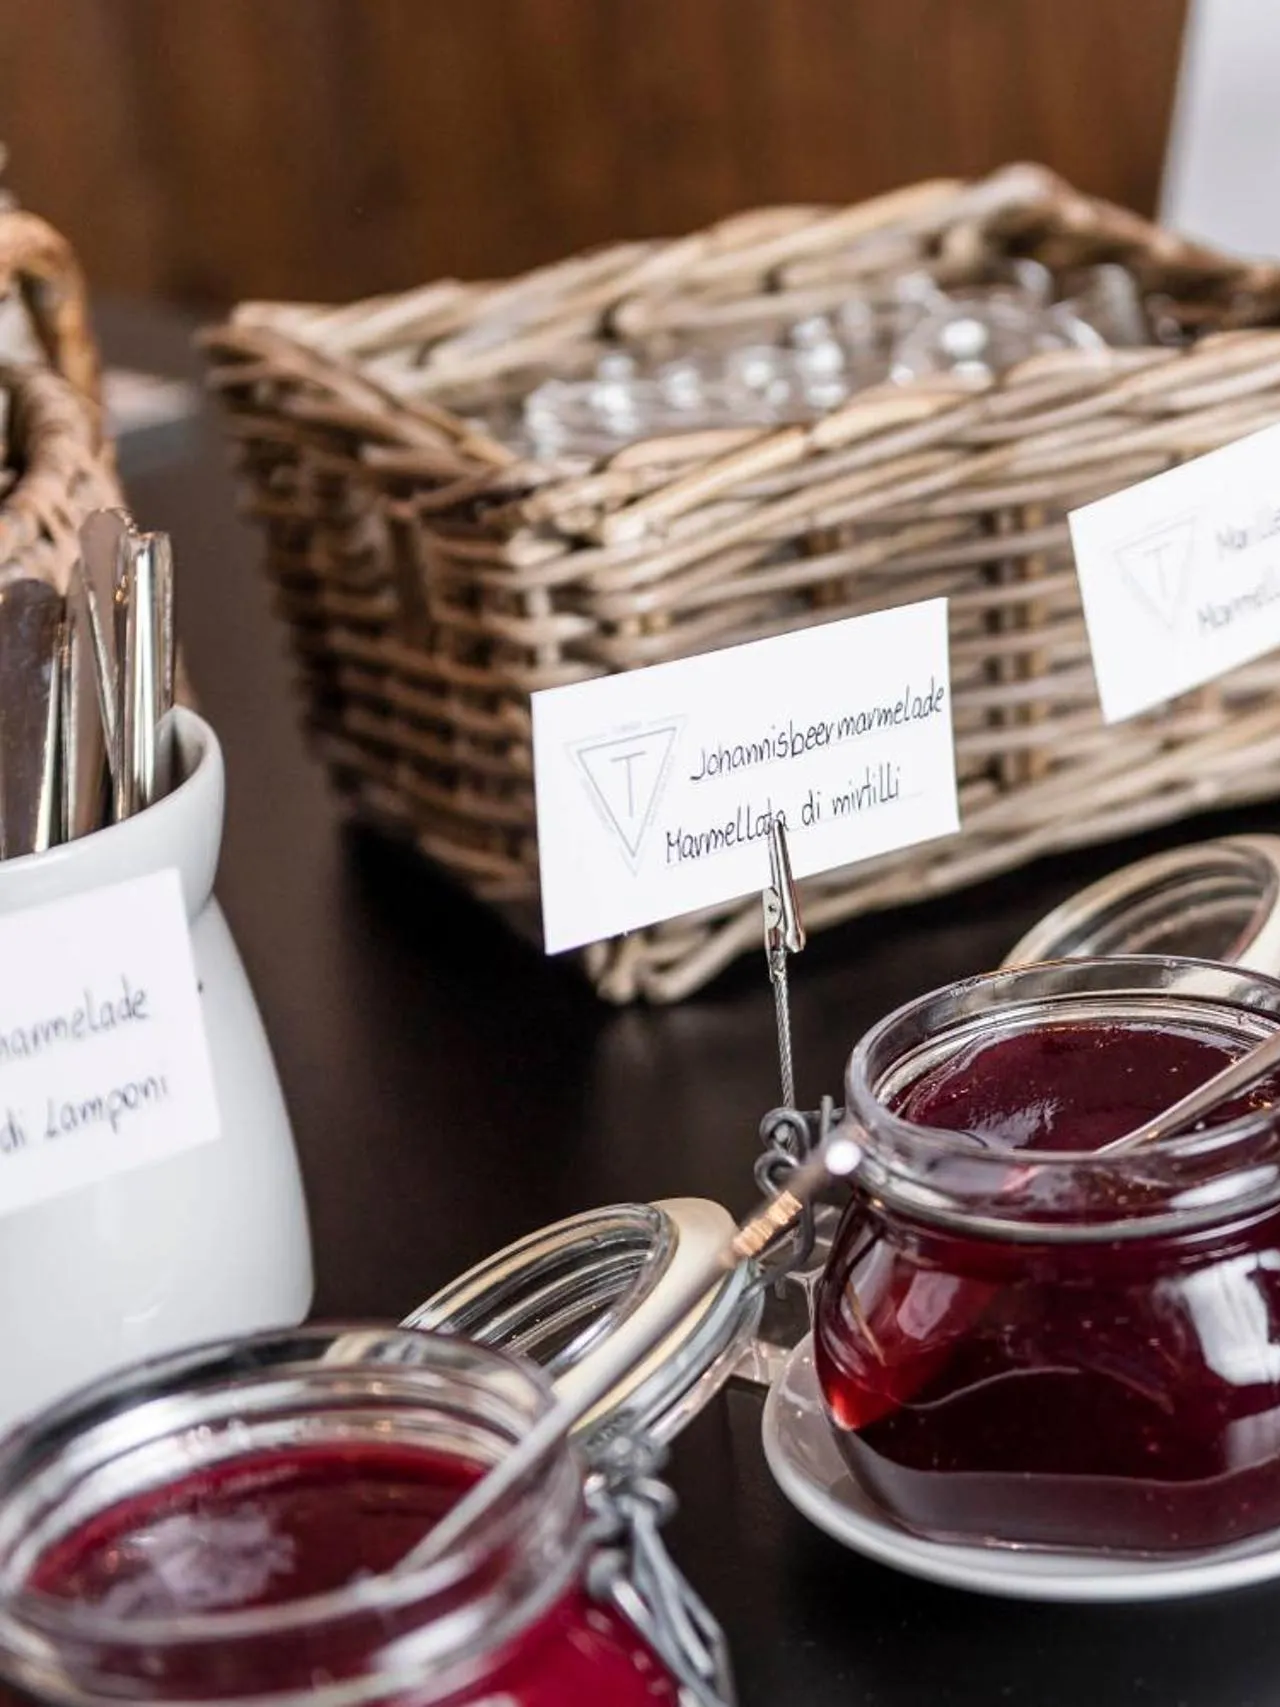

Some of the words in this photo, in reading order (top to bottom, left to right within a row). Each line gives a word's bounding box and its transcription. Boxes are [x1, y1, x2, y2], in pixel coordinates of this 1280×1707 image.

[690, 676, 944, 782] Johannisbeermarmelade
[610, 750, 647, 819] T
[665, 797, 789, 864] Marmellata
[802, 789, 821, 827] di
[831, 762, 901, 817] mirtilli
[0, 1107, 28, 1154] di
